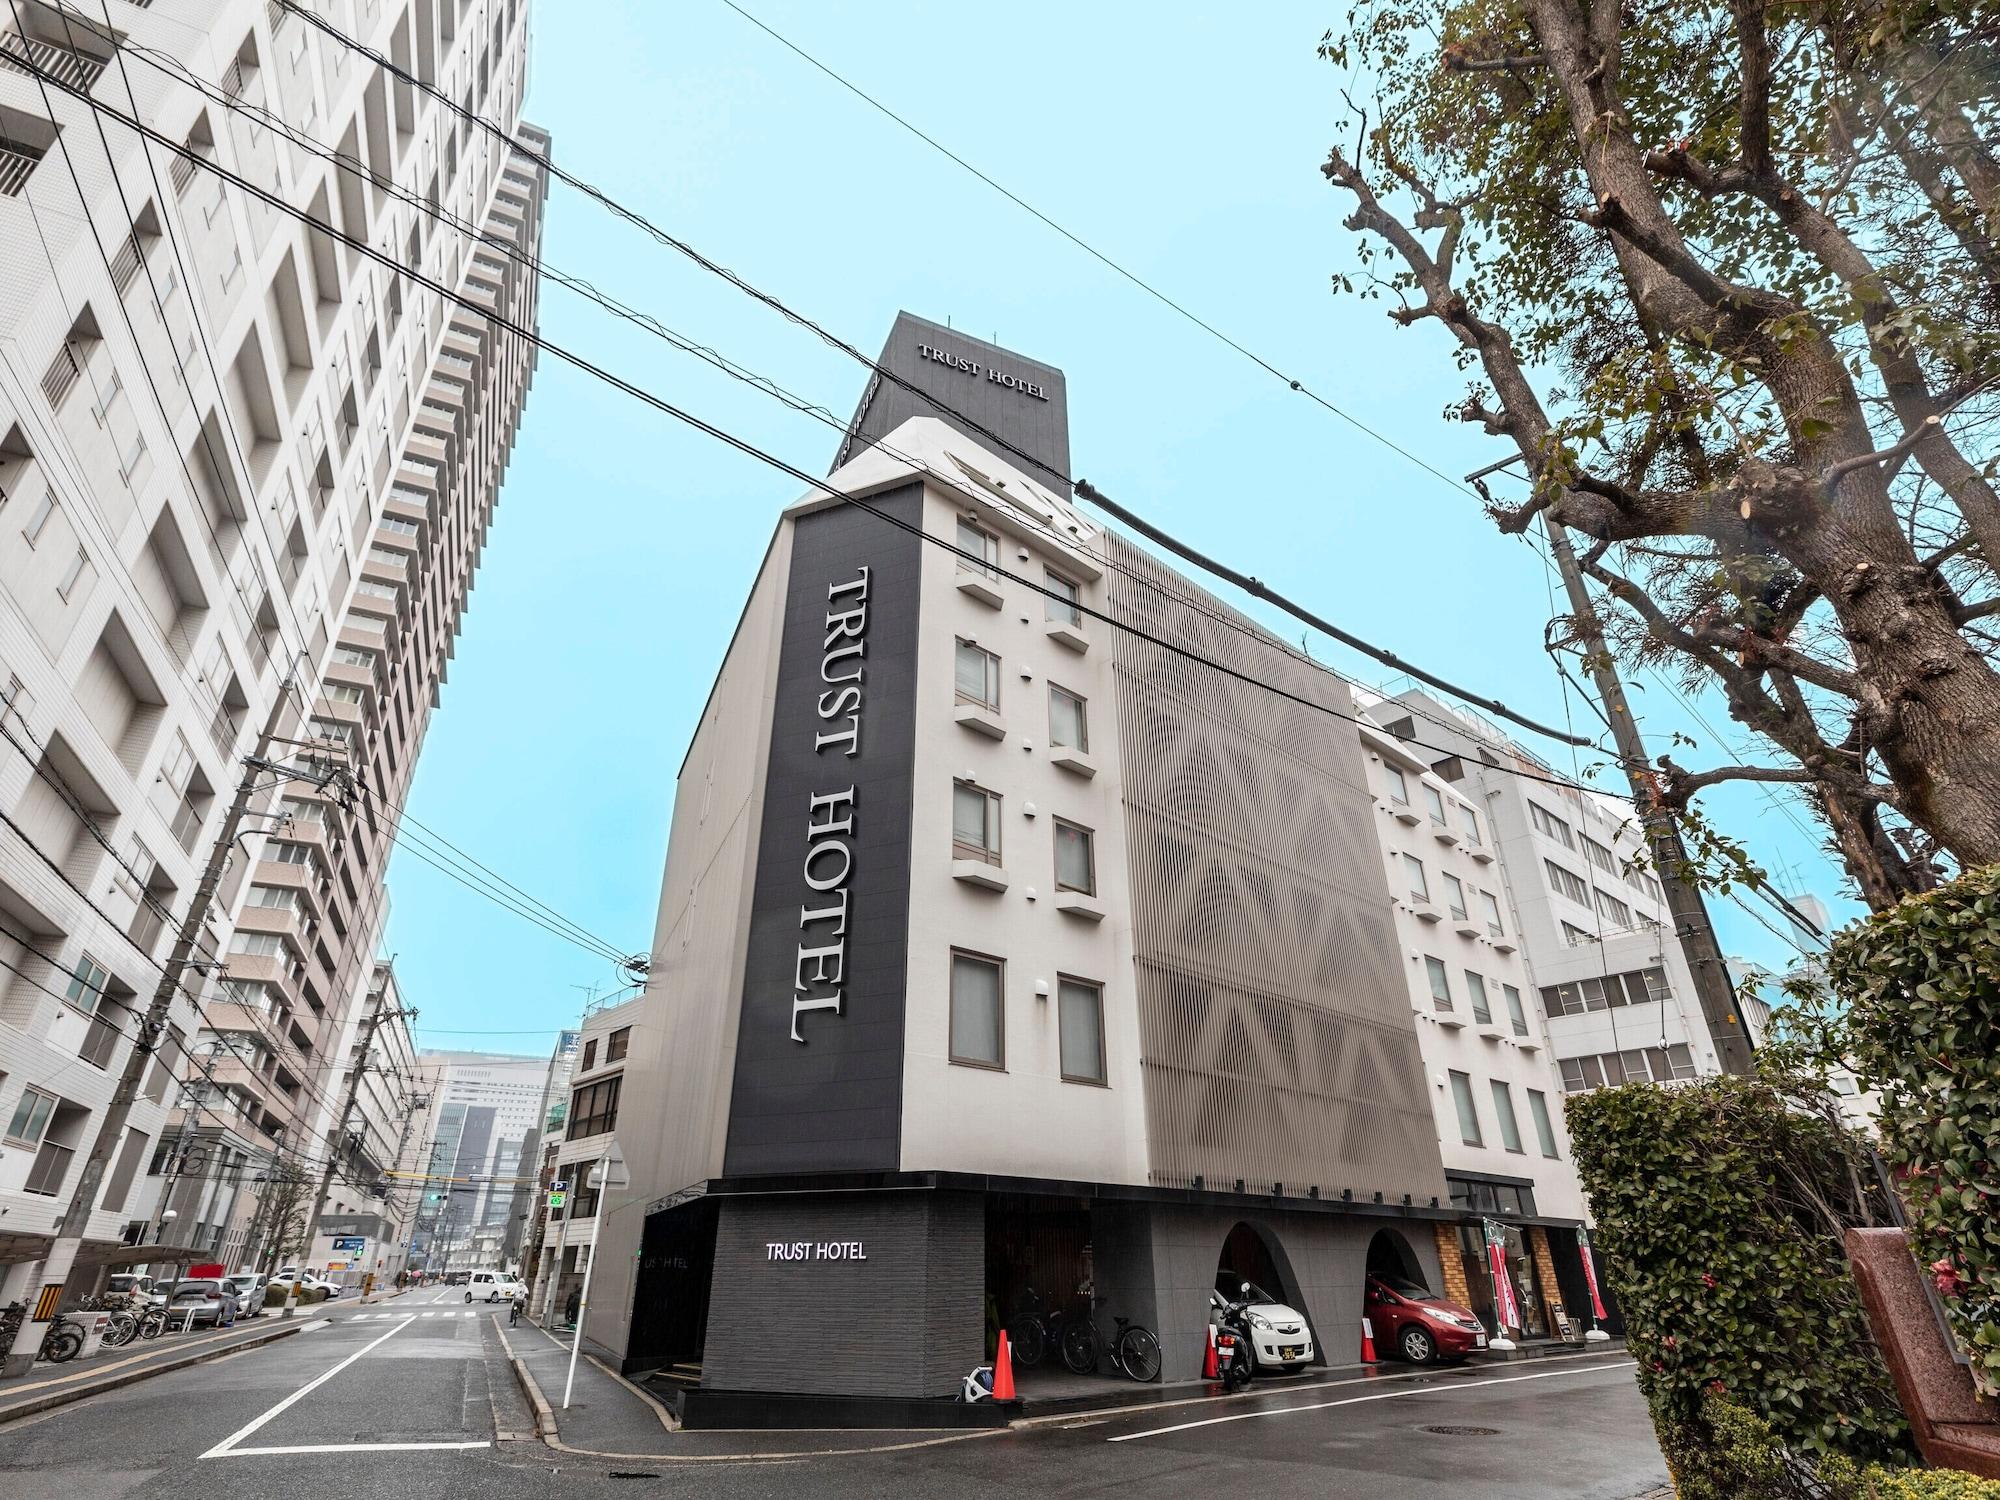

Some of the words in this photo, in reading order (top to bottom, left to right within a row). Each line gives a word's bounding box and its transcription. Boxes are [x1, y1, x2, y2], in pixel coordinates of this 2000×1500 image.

[918, 343, 981, 375] TRUST
[988, 368, 1050, 401] HOTEL
[815, 565, 869, 755] TRUST
[790, 784, 855, 1042] HOTEL
[553, 1182, 564, 1191] P
[766, 1242, 813, 1260] TRUST
[816, 1242, 867, 1260] HOTEL
